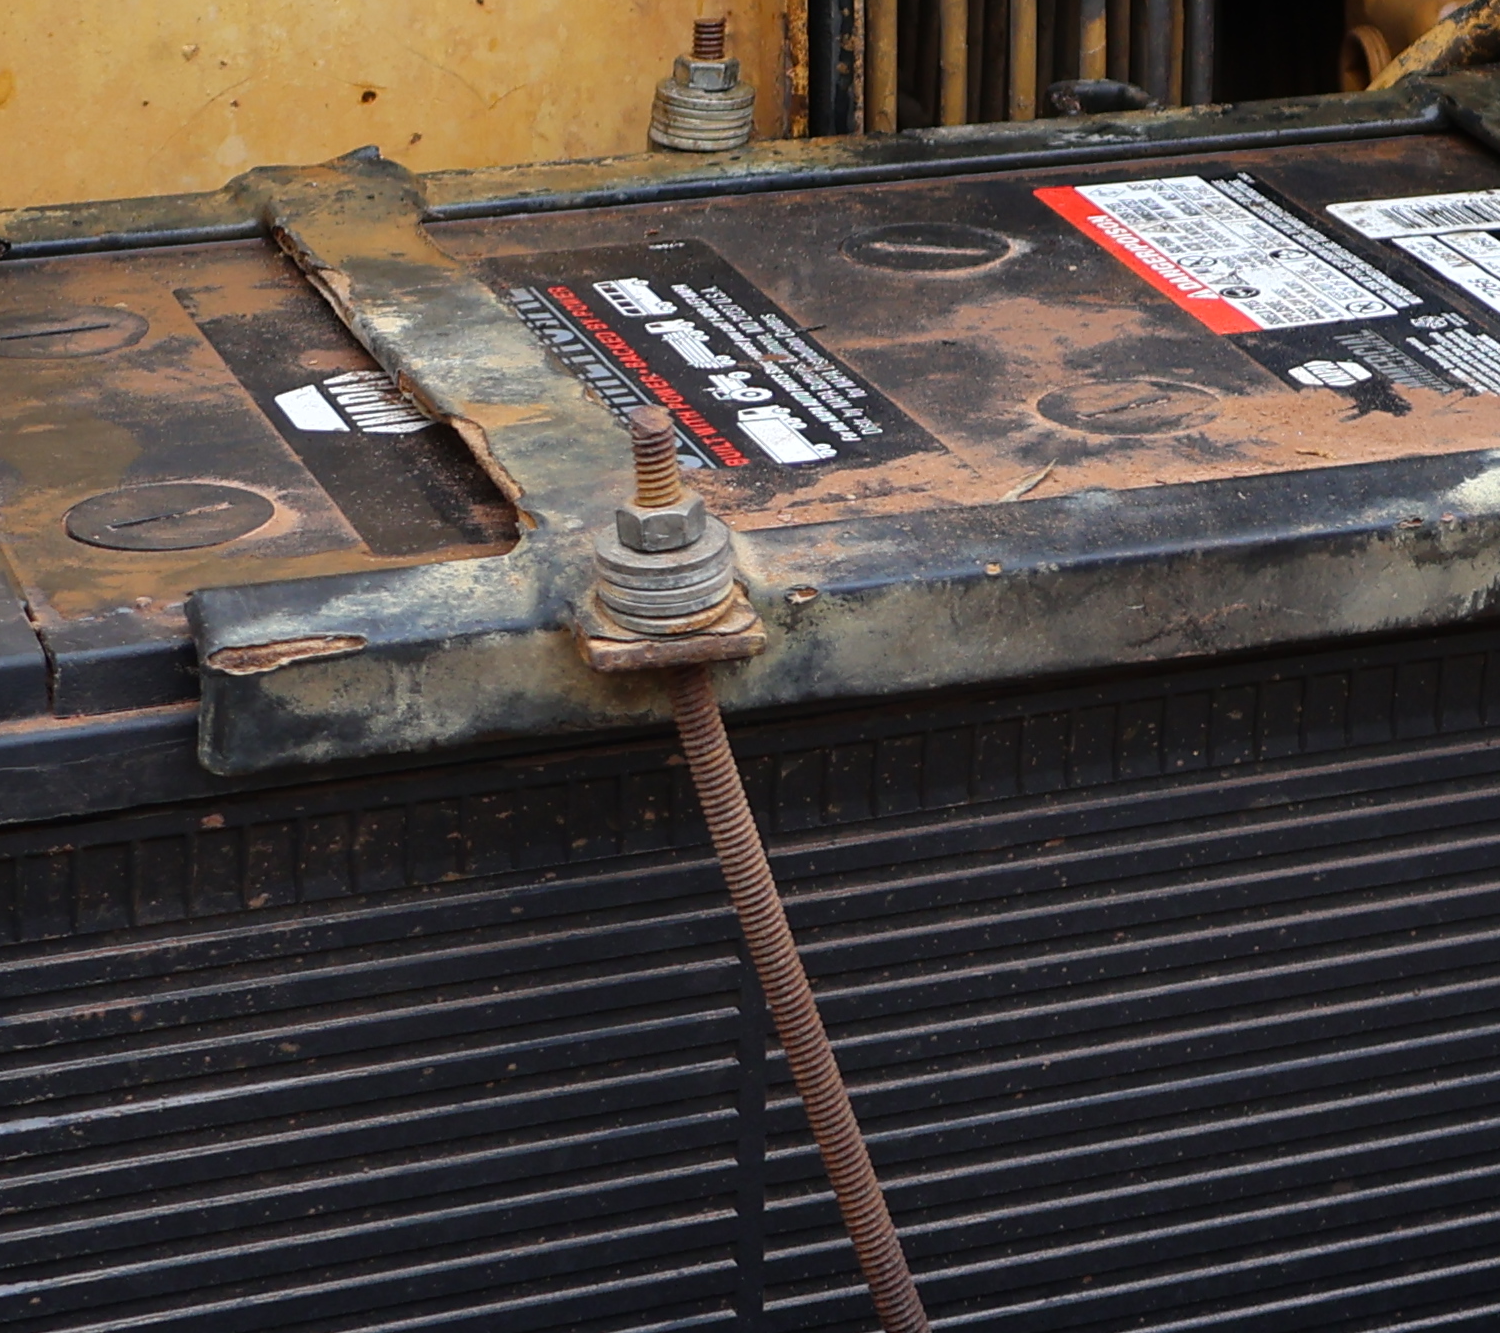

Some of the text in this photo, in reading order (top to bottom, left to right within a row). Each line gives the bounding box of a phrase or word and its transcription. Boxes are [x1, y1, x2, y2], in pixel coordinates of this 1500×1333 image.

[1087, 214, 1201, 292] DANGER/POISON
[547, 285, 594, 317] POWER
[580, 317, 610, 331] BY
[738, 321, 765, 333] MD
[760, 314, 796, 338] Centers
[593, 330, 649, 369] BACKED
[1332, 329, 1454, 394] MMERCIAL
[771, 372, 804, 392] PARTS
[821, 369, 856, 388] NAPA
[638, 374, 692, 410] POWER
[790, 391, 822, 406] AUTO
[817, 390, 852, 409] NAPA
[845, 388, 867, 398] for
[675, 409, 719, 436] WITH
[808, 405, 838, 422] NAPA
[834, 407, 864, 418] by
[700, 436, 751, 467] BUILT
